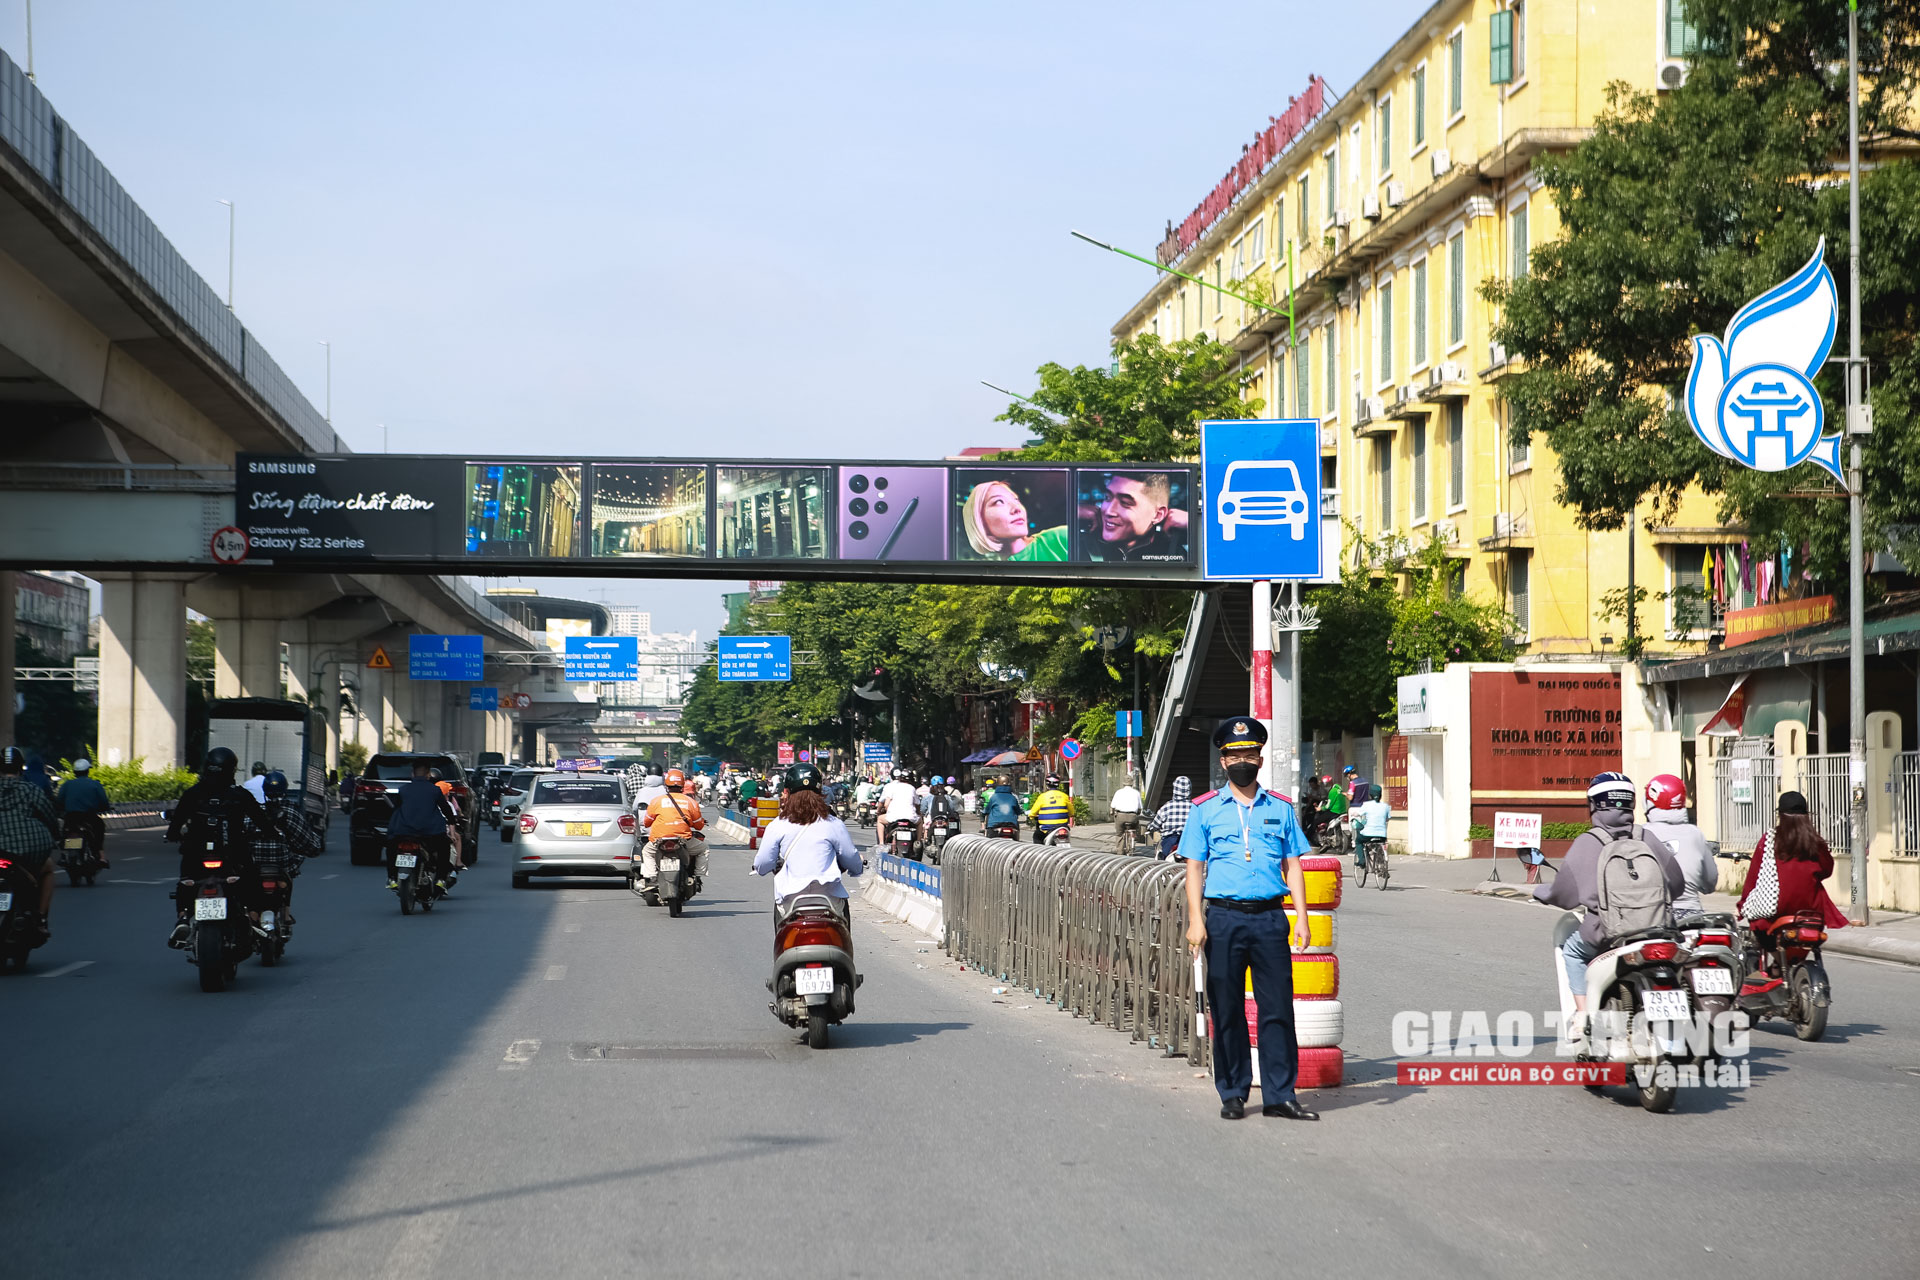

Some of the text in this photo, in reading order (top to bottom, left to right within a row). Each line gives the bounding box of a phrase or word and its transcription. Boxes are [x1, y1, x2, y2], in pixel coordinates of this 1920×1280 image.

[249, 462, 316, 475] SAMSUNG
[249, 491, 434, 518] Sống đậm chất đêm
[249, 526, 309, 536] Captured with
[216, 536, 244, 552] 4.5m
[249, 537, 365, 550] Galaxy S22 Series
[1141, 554, 1184, 562] samsung.com
[1537, 680, 1556, 692] ĐẠI
[1558, 681, 1579, 692] HỌC
[1583, 679, 1611, 690] QUỐC
[1544, 706, 1622, 726] TRƯỜNG ĐẠ
[1491, 729, 1530, 744] KHOA
[1534, 730, 1562, 746] HỌC
[1566, 727, 1588, 744] XÃ
[1591, 725, 1614, 747] HỘI
[1553, 748, 1561, 757] OF
[1564, 748, 1588, 757] SOCIAL
[1499, 817, 1511, 827] XE
[802, 969, 828, 981] 29-F1
[1699, 970, 1726, 981] 29-C1
[1649, 992, 1681, 1004] 29-C1
